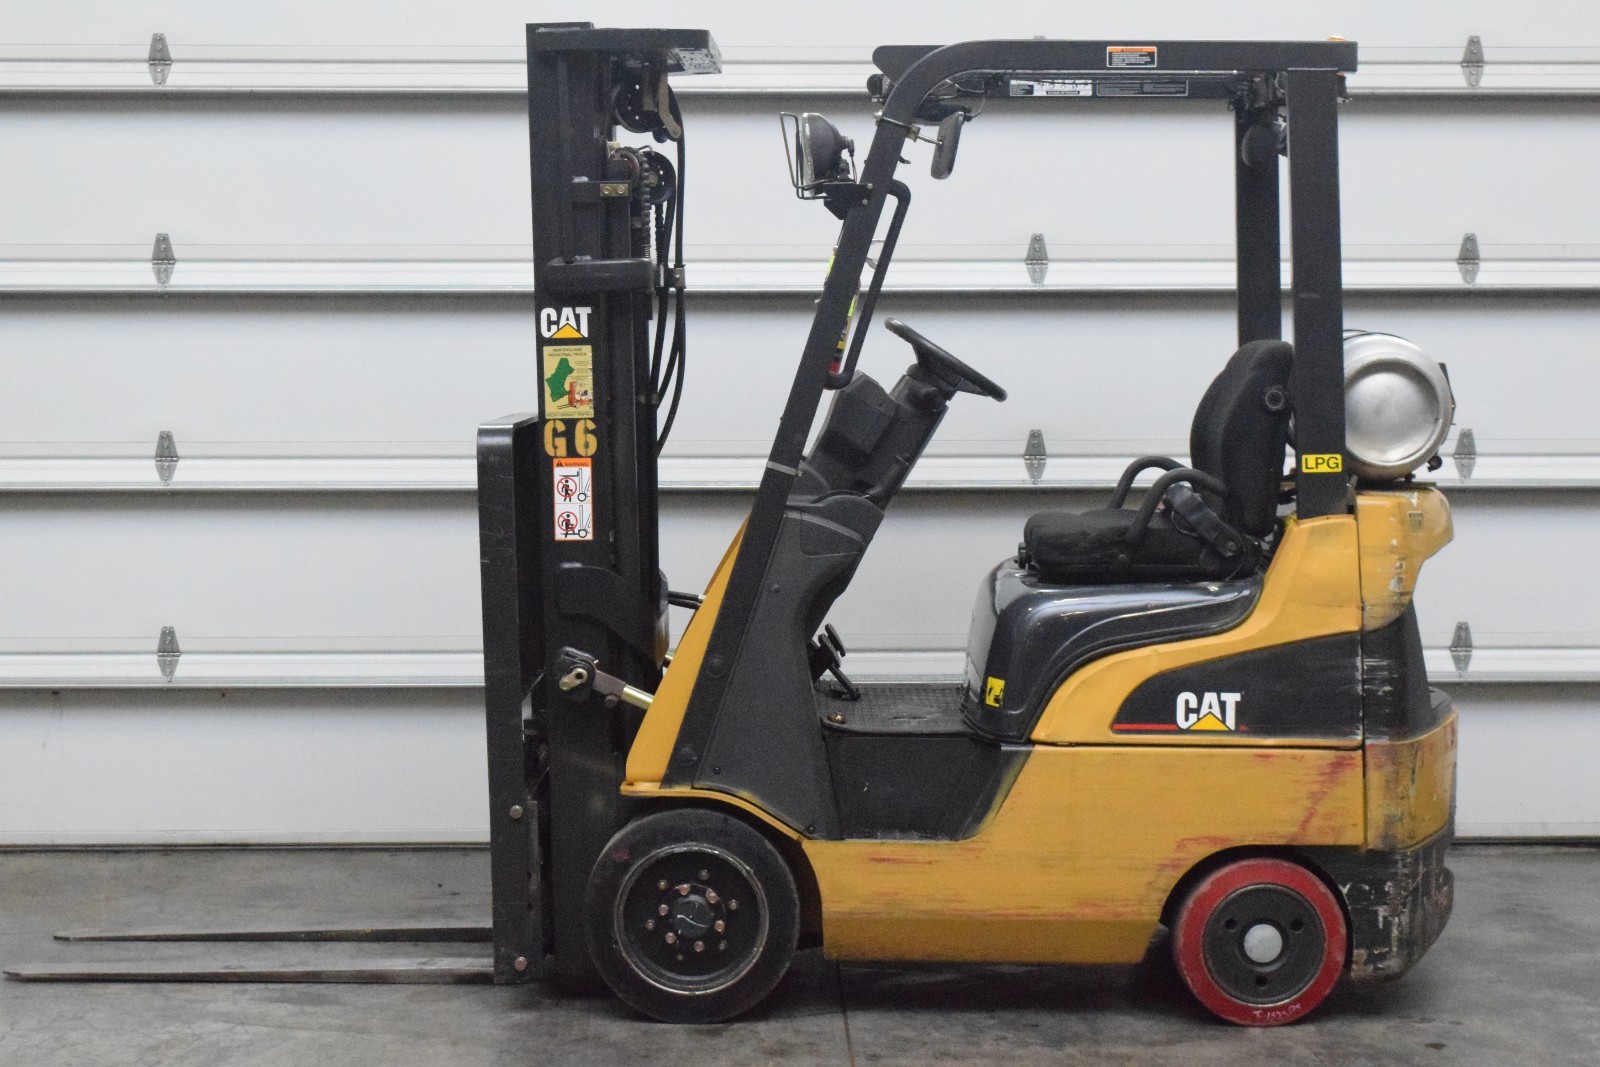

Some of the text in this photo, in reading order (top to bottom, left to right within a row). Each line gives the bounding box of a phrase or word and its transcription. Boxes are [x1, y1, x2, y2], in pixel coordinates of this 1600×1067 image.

[541, 306, 592, 338] CAT
[1304, 456, 1339, 470] LPG
[1176, 691, 1242, 731] CAT
